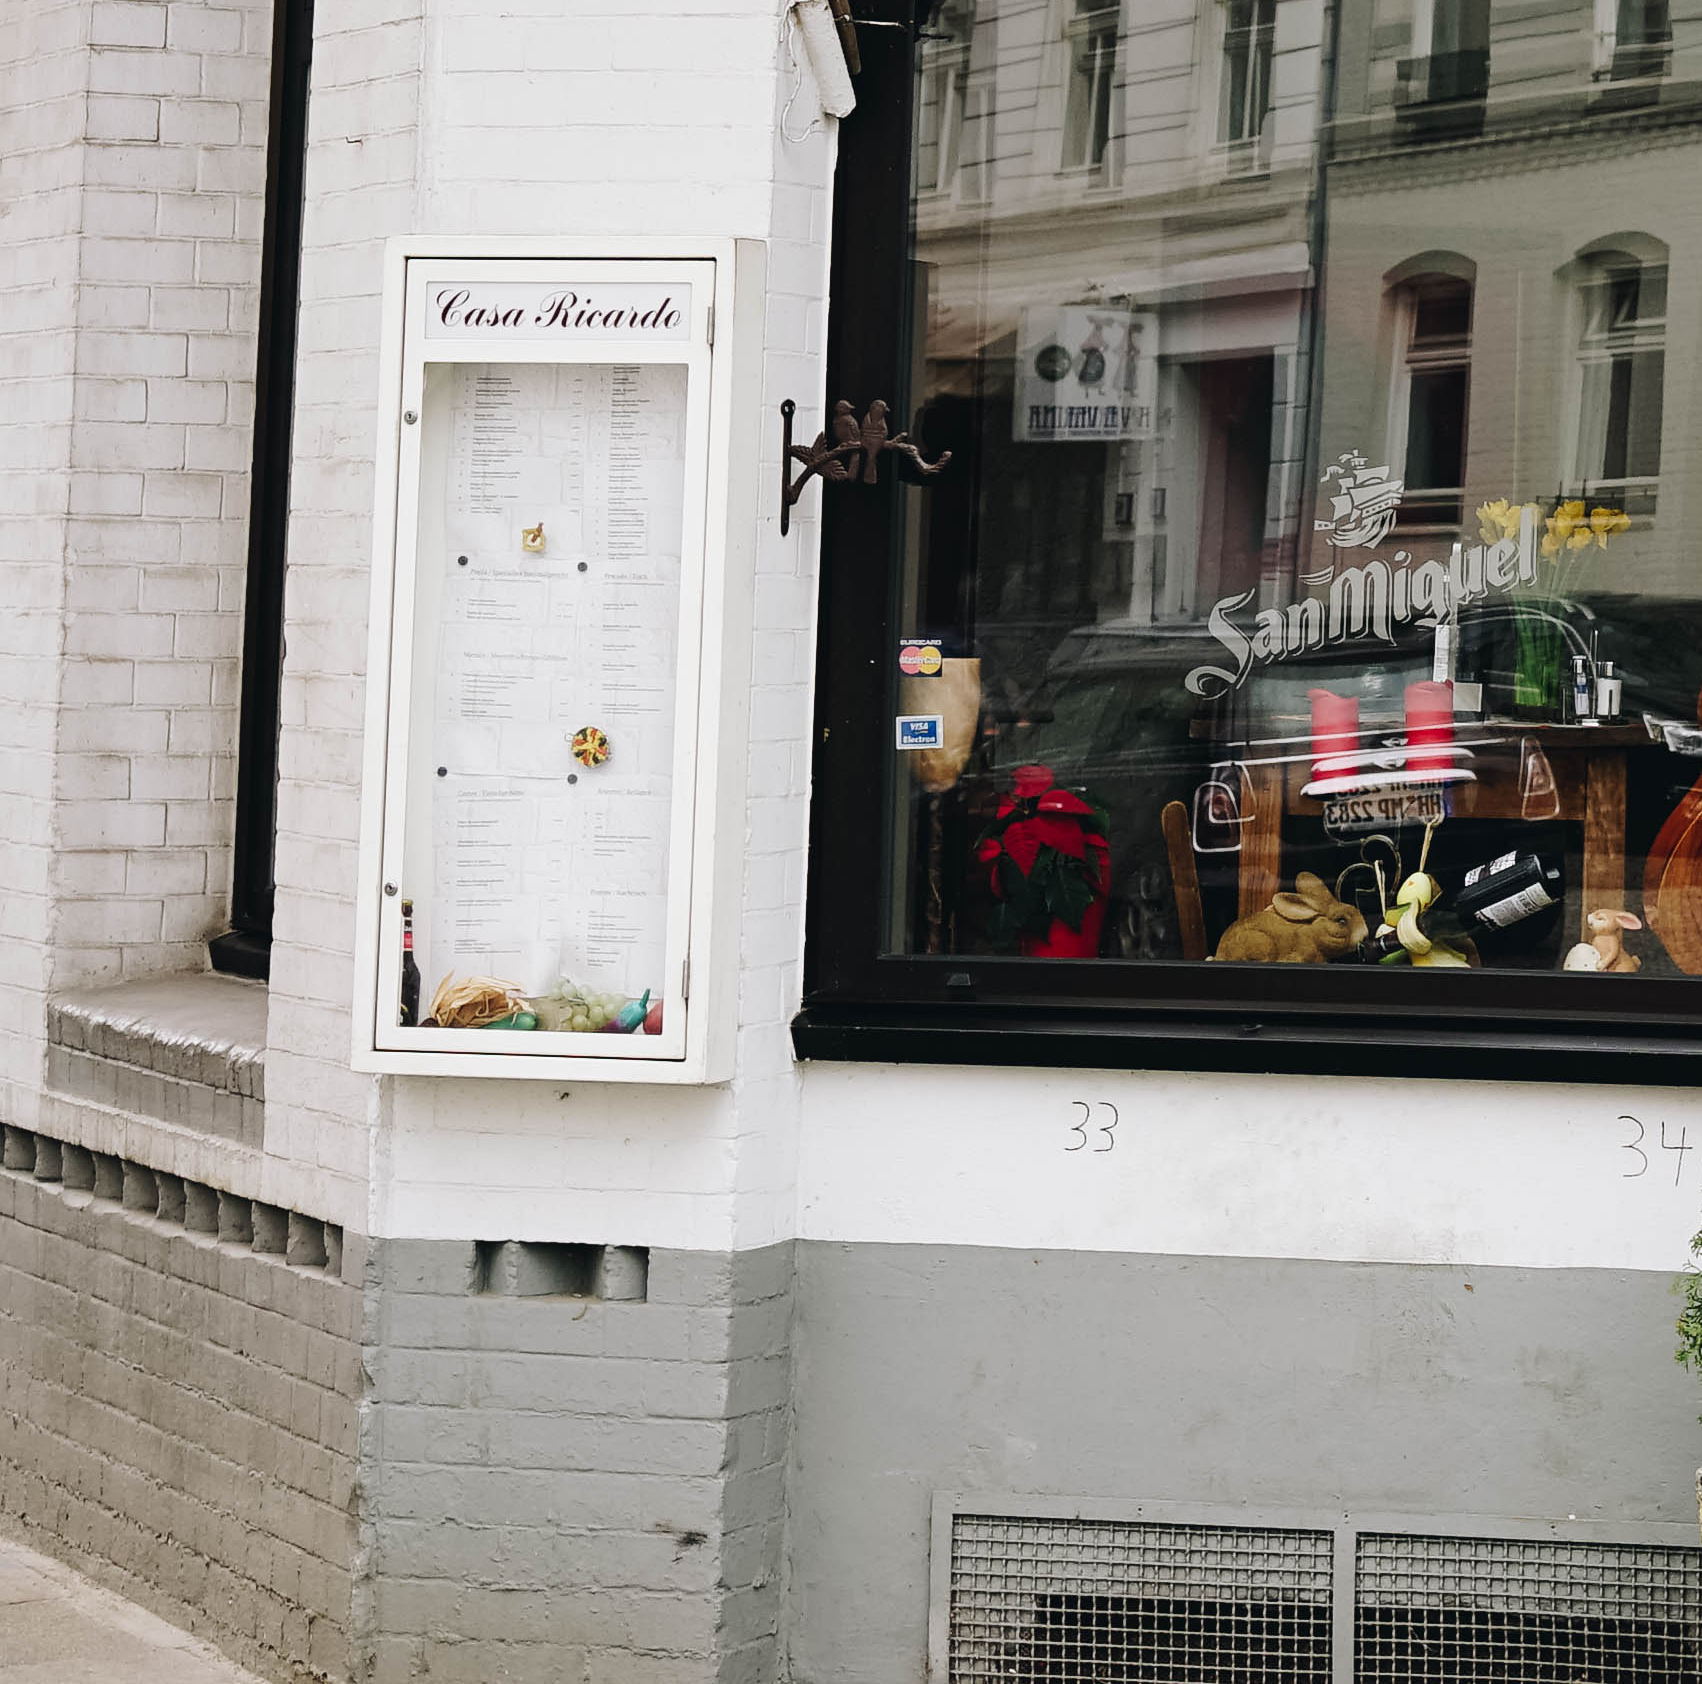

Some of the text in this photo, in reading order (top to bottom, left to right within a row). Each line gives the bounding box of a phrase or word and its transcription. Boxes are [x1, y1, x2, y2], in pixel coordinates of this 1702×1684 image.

[435, 288, 682, 330] Casa Ricardo
[1064, 1101, 1119, 1152] 33
[1617, 1115, 1693, 1187] 34
